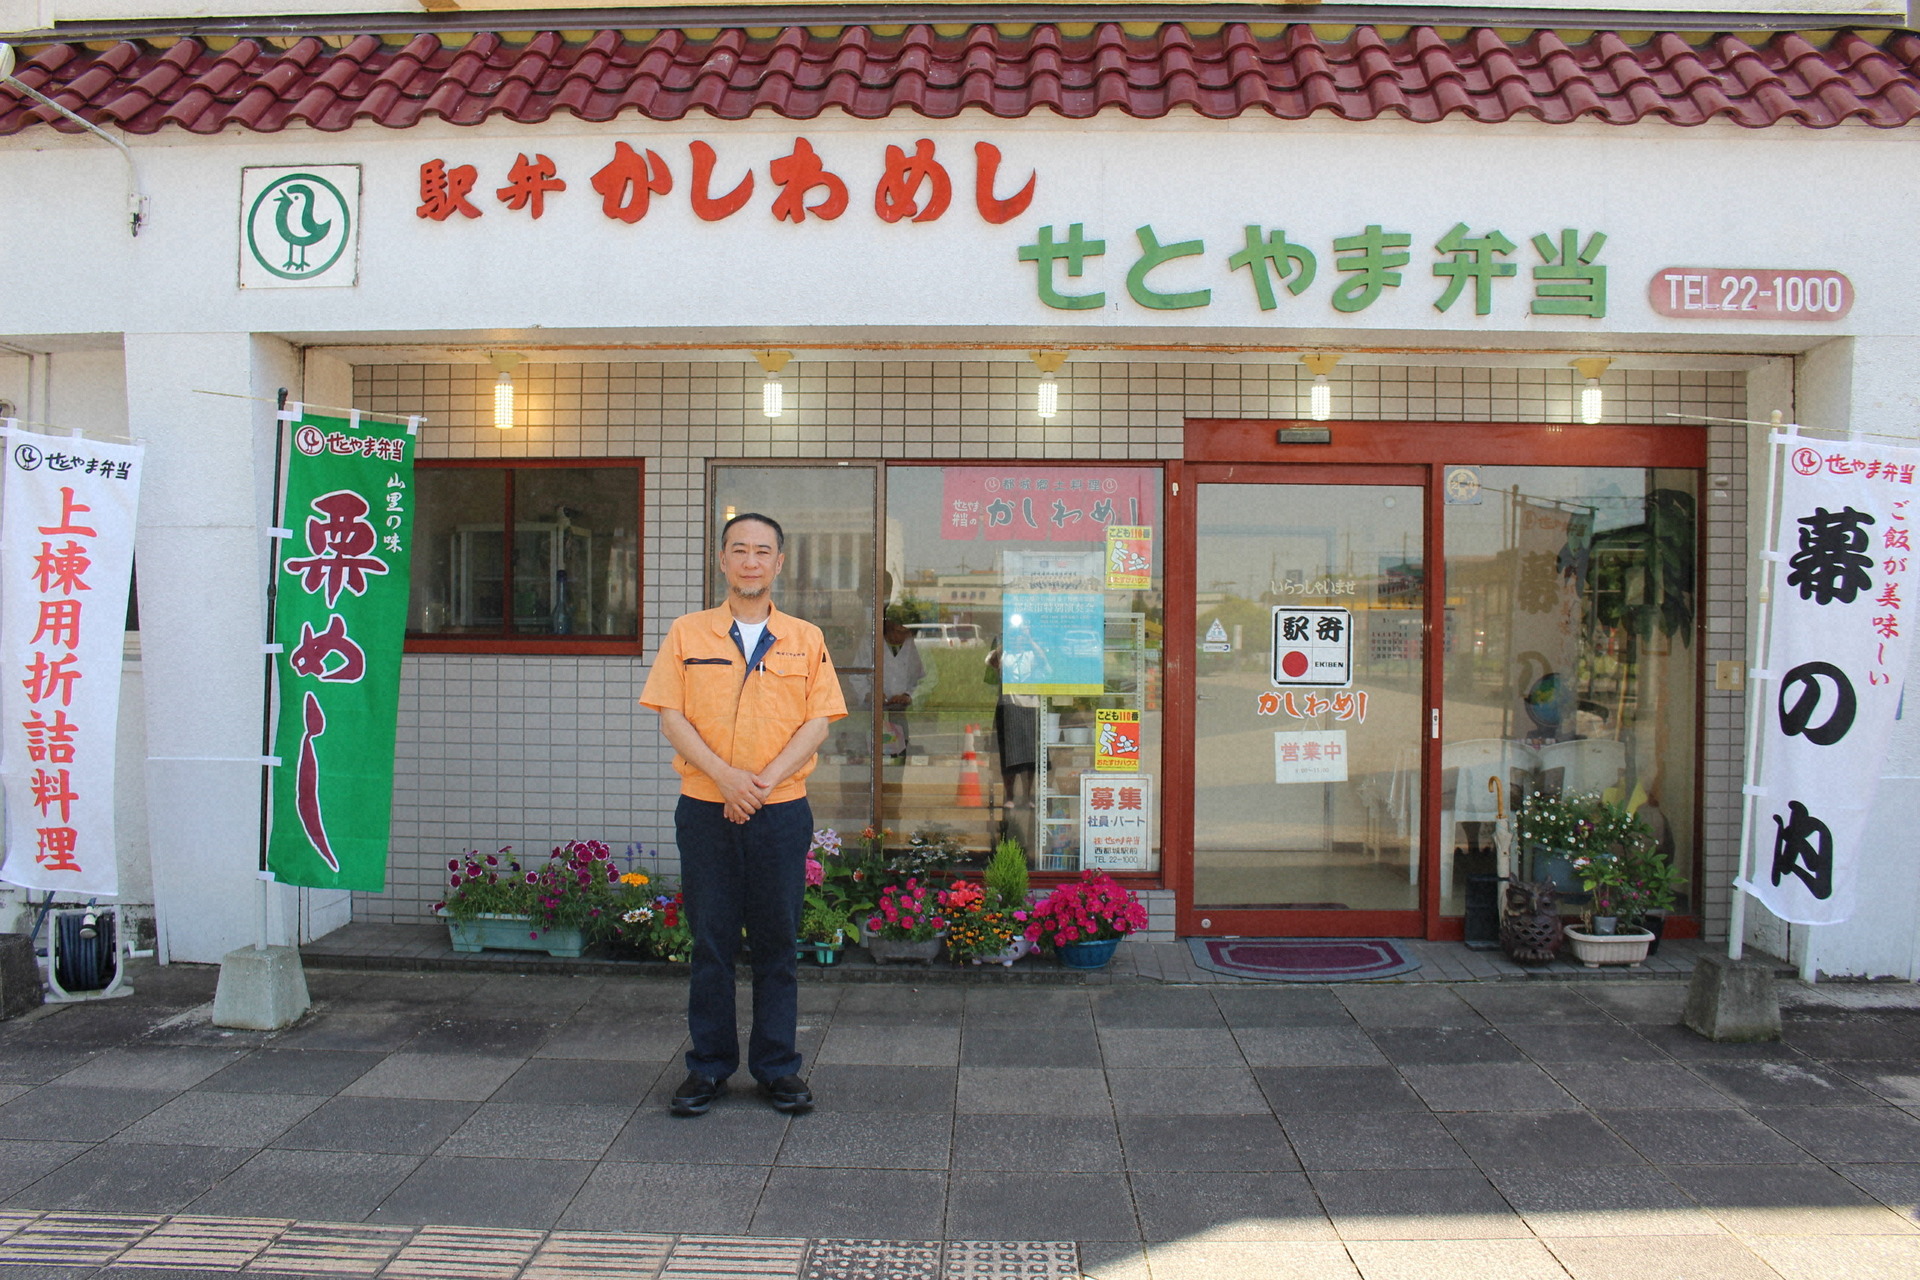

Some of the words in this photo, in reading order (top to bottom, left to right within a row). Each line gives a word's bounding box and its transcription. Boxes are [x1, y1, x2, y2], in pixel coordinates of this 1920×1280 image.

[1019, 222, 1608, 318] せとやま弁当
[326, 432, 404, 461] せとやま弁当
[45, 453, 132, 480] せとやま弁当
[1824, 454, 1916, 484] せとやま弁当
[383, 472, 406, 554] 山里の味
[986, 497, 1137, 531] かしわめし
[1271, 579, 1356, 595] いらっしゃいませ
[1868, 500, 1911, 687] ご飯が美味しい
[1283, 615, 1344, 643] 駅弁
[22, 486, 98, 873] 上棟用折詰料理
[285, 491, 389, 872] 栗めし
[1097, 711, 1139, 721] こども110番
[1257, 690, 1369, 724] かしわめし
[1771, 506, 1875, 900] 幕の内
[1096, 759, 1138, 767] おたすけハウス
[1280, 741, 1342, 763] 営業中
[1090, 787, 1142, 810] 募集
[1094, 846, 1138, 855] 西都城駅前
